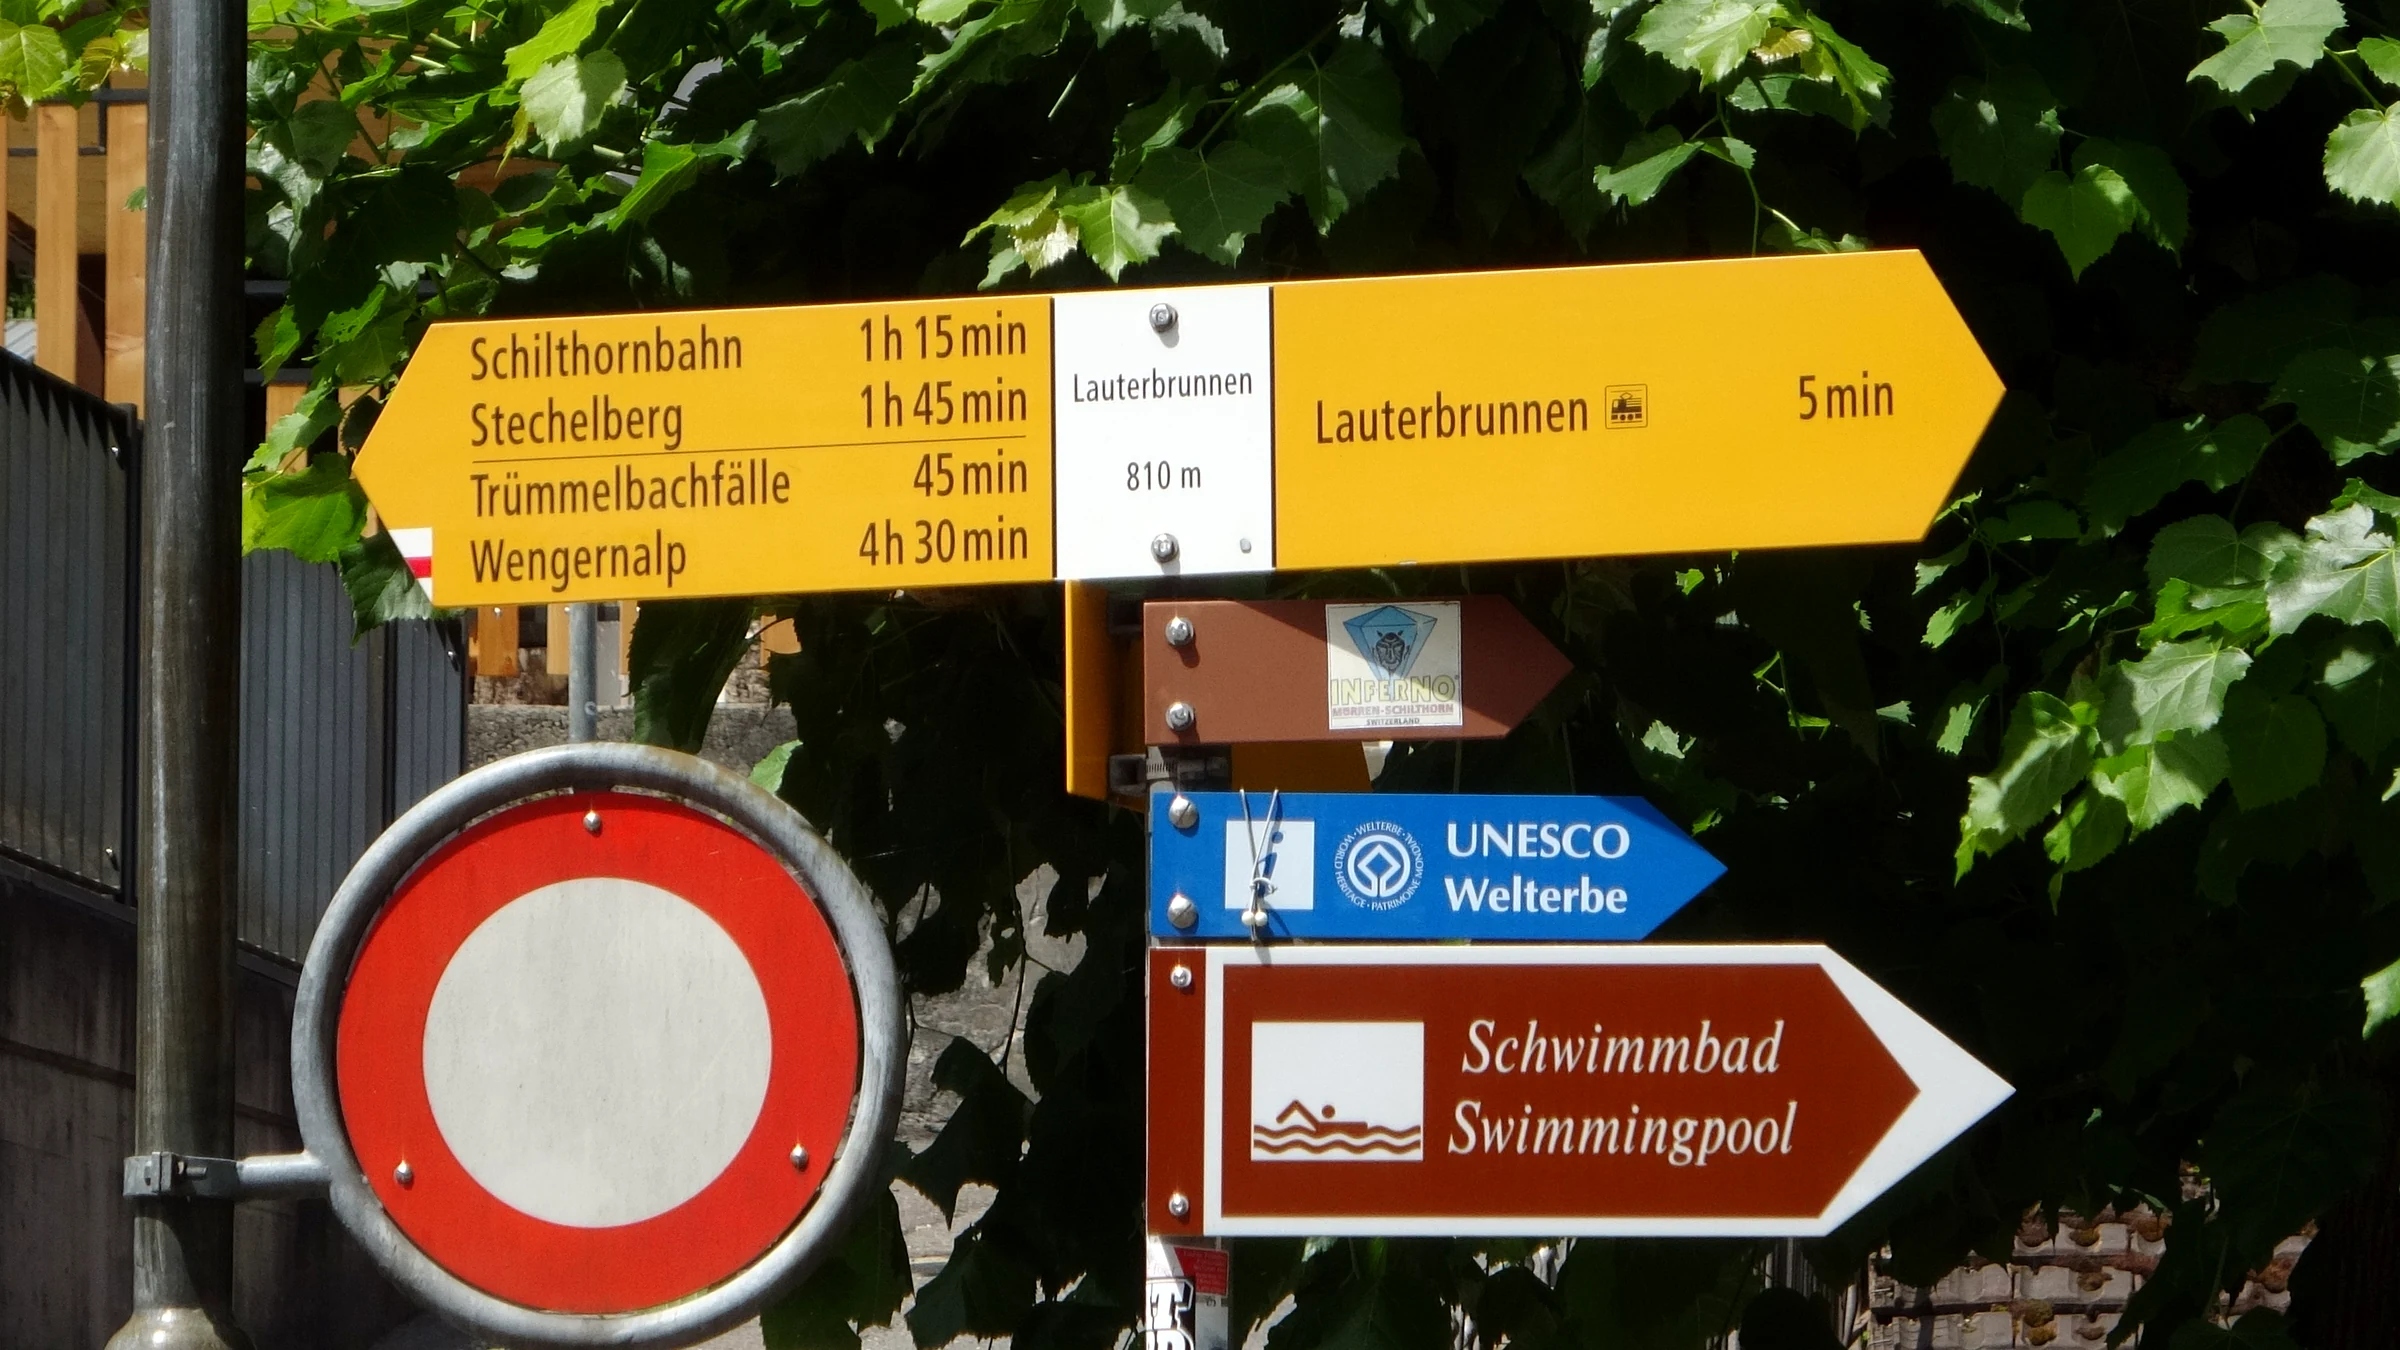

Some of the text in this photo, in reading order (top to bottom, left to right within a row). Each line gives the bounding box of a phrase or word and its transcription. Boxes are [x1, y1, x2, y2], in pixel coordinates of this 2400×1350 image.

[471, 324, 742, 381] Schilthornbahn
[1074, 367, 1253, 403] Lauterbrunnen
[471, 394, 683, 451] Stechelberg
[1317, 390, 1589, 444] Lauterbrunnen
[471, 458, 791, 518] Trümmelbachfälle
[1127, 460, 1202, 491] 810 m
[471, 528, 687, 593] Wengernalp
[1366, 717, 1420, 727] SWITZERLAND
[1355, 821, 1404, 836] WELTERBE
[1446, 822, 1631, 860] UNESCO
[1334, 834, 1367, 909] WORLD HERITAGE
[1371, 832, 1425, 911] PATRIMOINE MONDIAL
[1443, 873, 1628, 914] Welterbe
[1461, 1018, 1785, 1074] Schwimmbad
[1447, 1099, 1798, 1167] Swimmingpool
